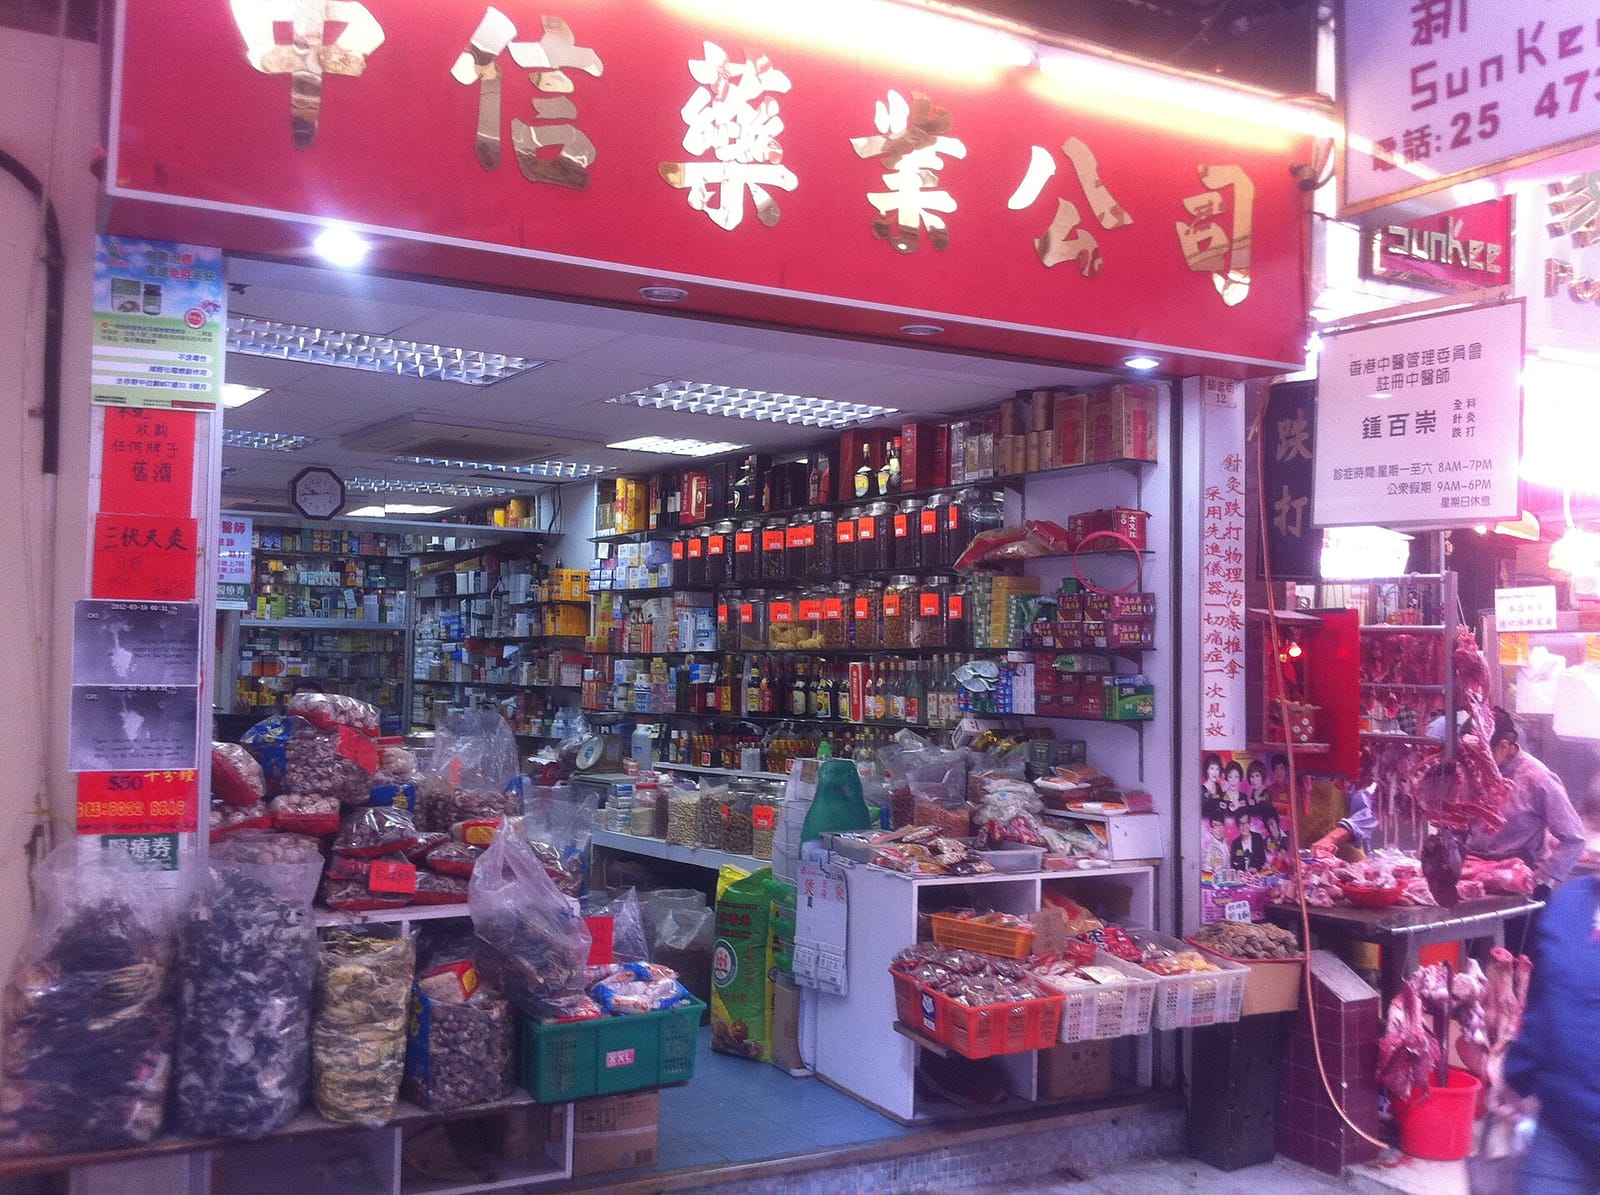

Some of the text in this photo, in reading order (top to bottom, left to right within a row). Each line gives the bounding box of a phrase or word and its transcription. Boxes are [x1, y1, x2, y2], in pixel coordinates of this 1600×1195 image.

[1534, 69, 1600, 119] 47
[1349, 342, 1482, 377] 香港中醫管理委員會
[1376, 367, 1450, 392] 註冊中醫師
[1361, 410, 1437, 440] 鍾百崇
